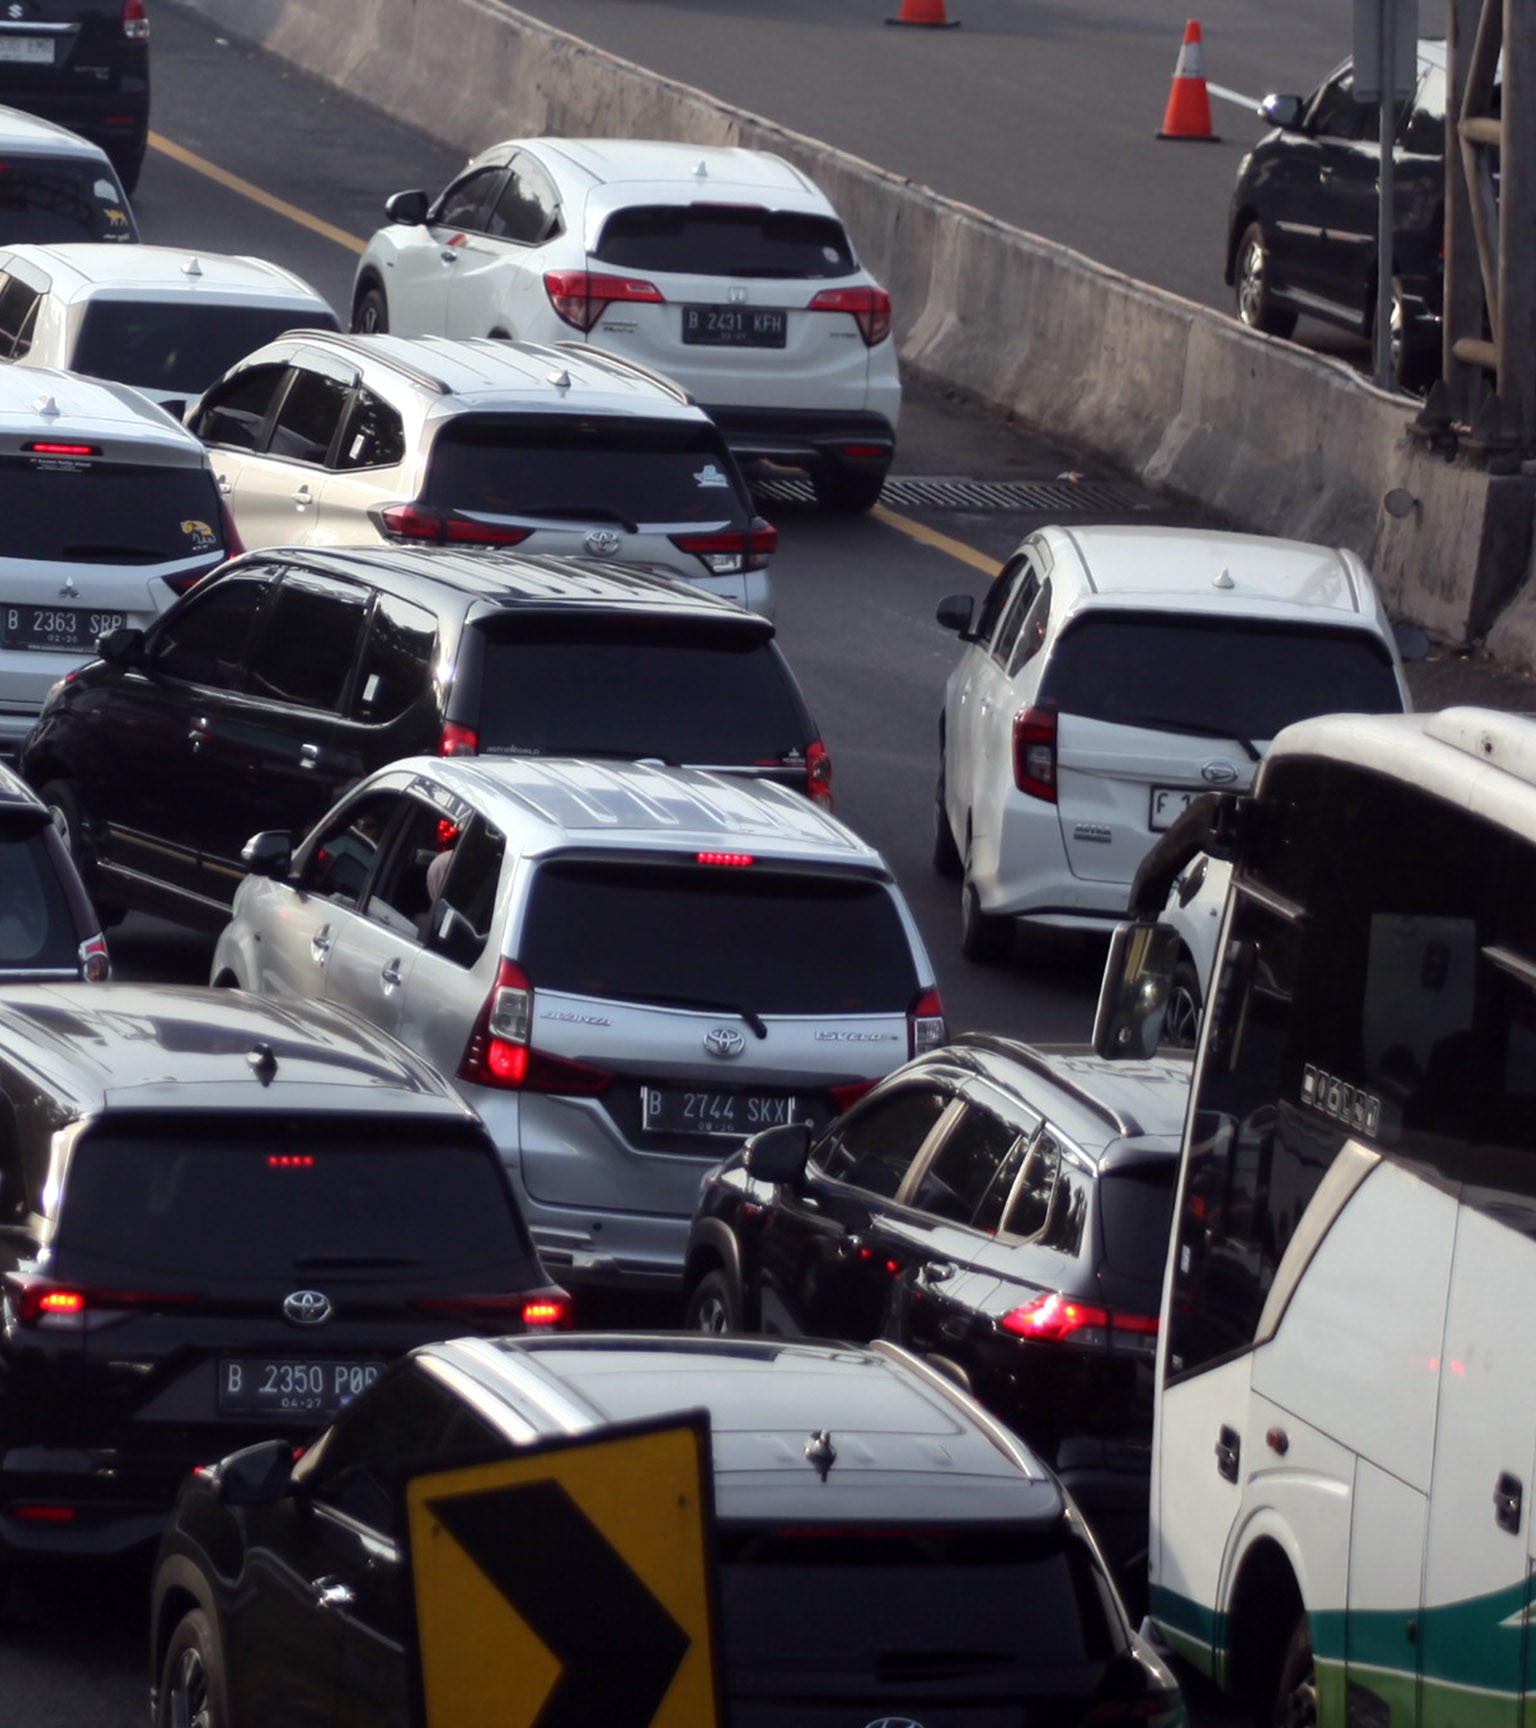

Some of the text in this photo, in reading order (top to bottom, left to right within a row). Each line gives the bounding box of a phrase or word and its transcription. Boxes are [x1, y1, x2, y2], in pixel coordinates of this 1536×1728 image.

[688, 311, 698, 330] B
[707, 312, 743, 332] 2431
[7, 608, 19, 630] B
[32, 610, 77, 633] 2363
[1156, 792, 1169, 814] F
[649, 1091, 787, 1124] B 2744 SKX
[228, 1363, 243, 1393] B
[258, 1364, 324, 1394] 2350
